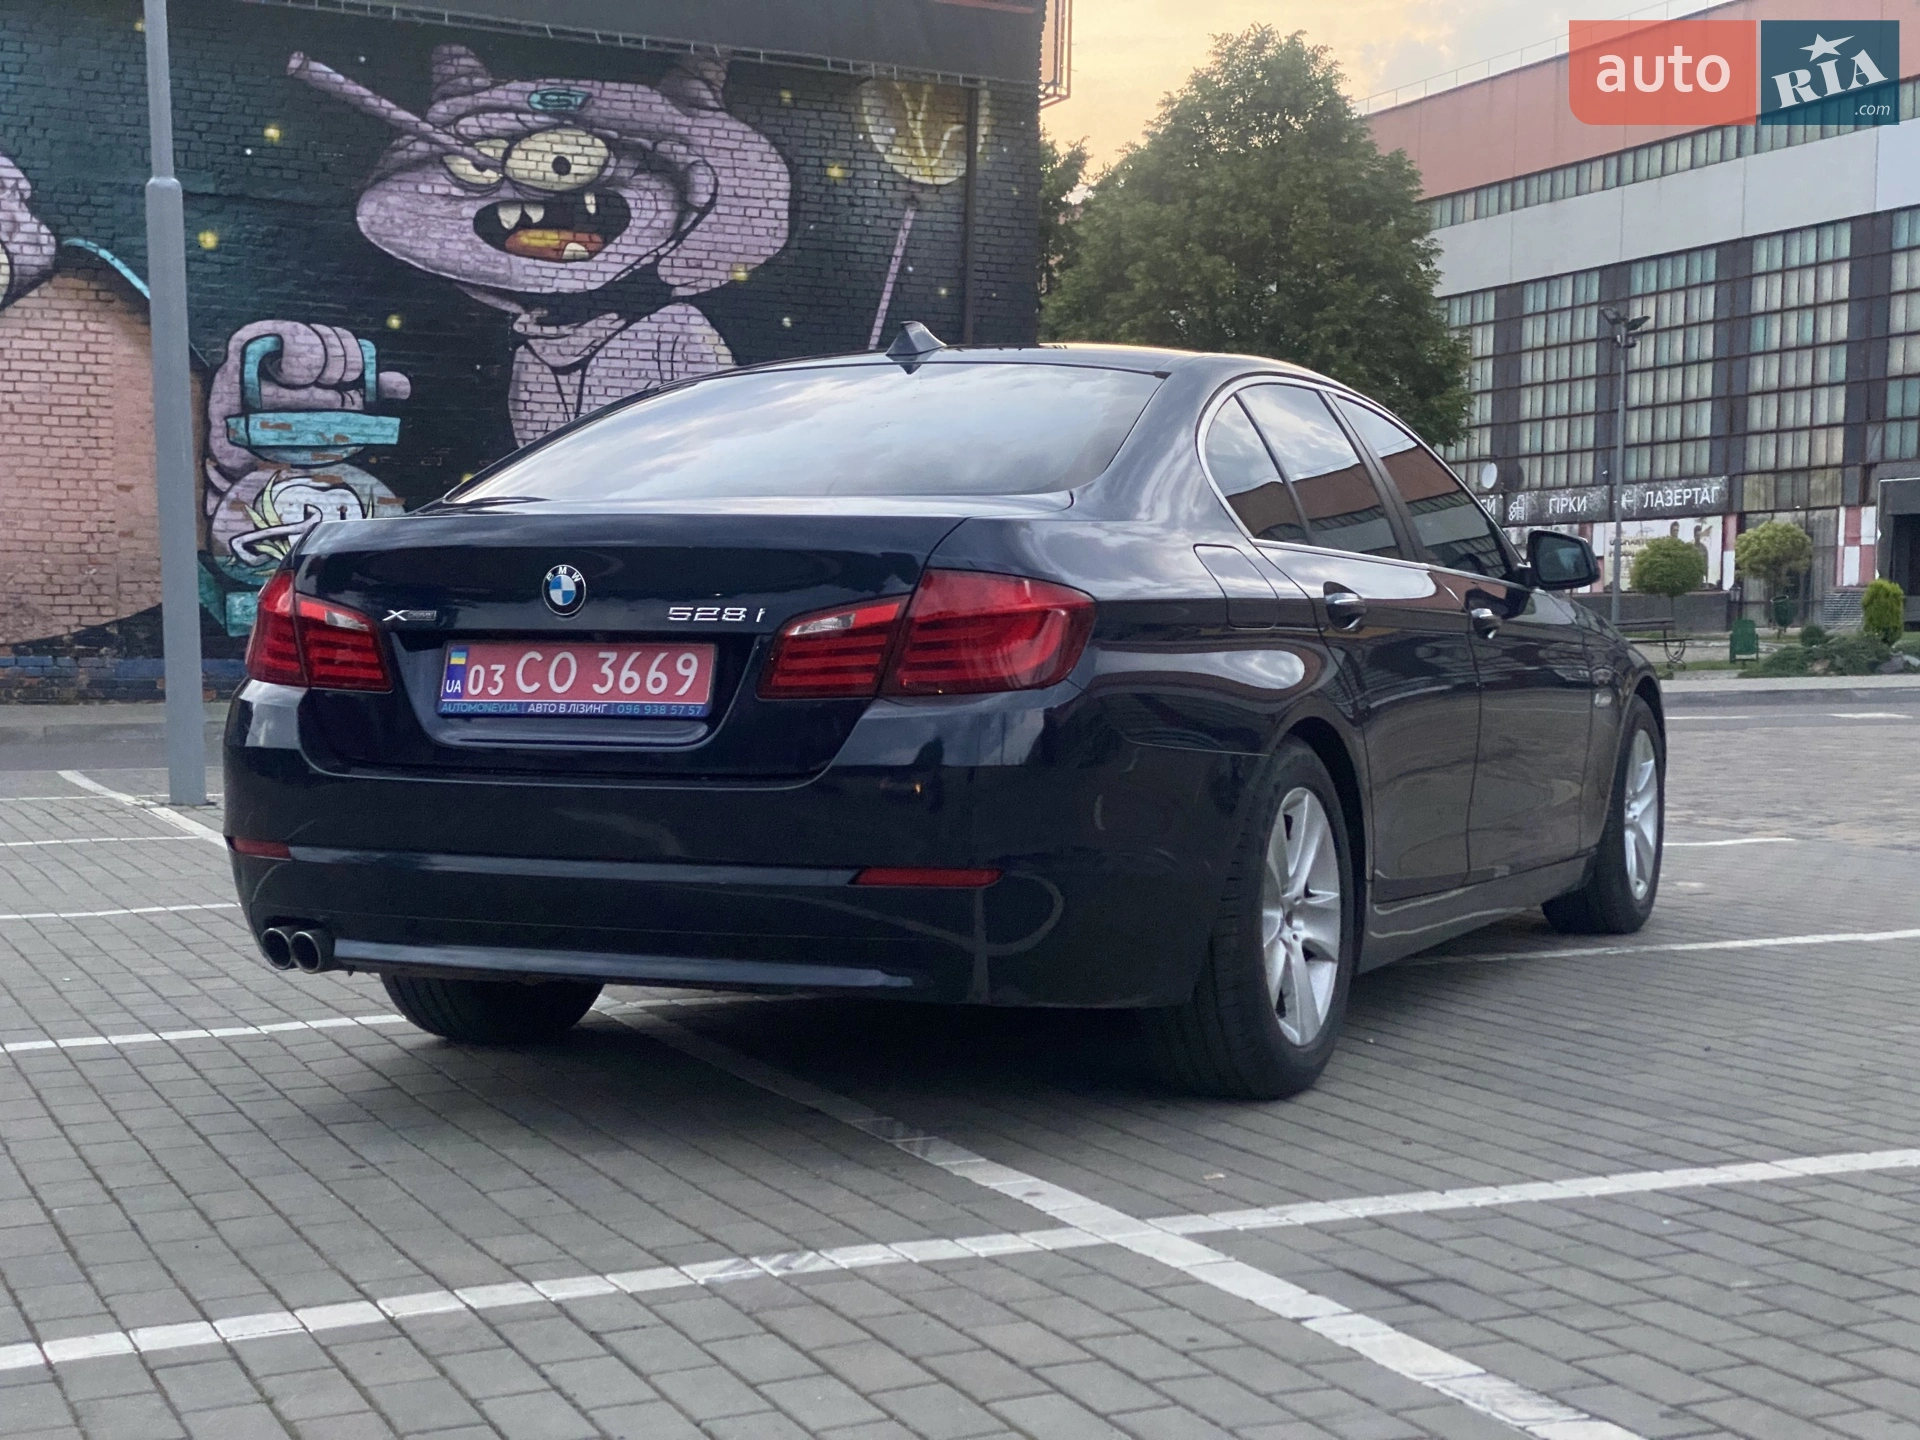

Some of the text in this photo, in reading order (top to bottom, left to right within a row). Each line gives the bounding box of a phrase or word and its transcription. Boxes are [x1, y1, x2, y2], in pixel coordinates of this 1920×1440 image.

[1548, 495, 1587, 515] ГІРКИ
[1643, 486, 1721, 509] ЛАЗЕРТАГ
[545, 565, 582, 584] BMW
[467, 650, 699, 696] 03 CO 3669
[445, 679, 462, 693] UA
[527, 703, 557, 713] АВТО
[567, 703, 608, 714] ЛІЗИНГ
[617, 704, 703, 716] 096 938 57 57
